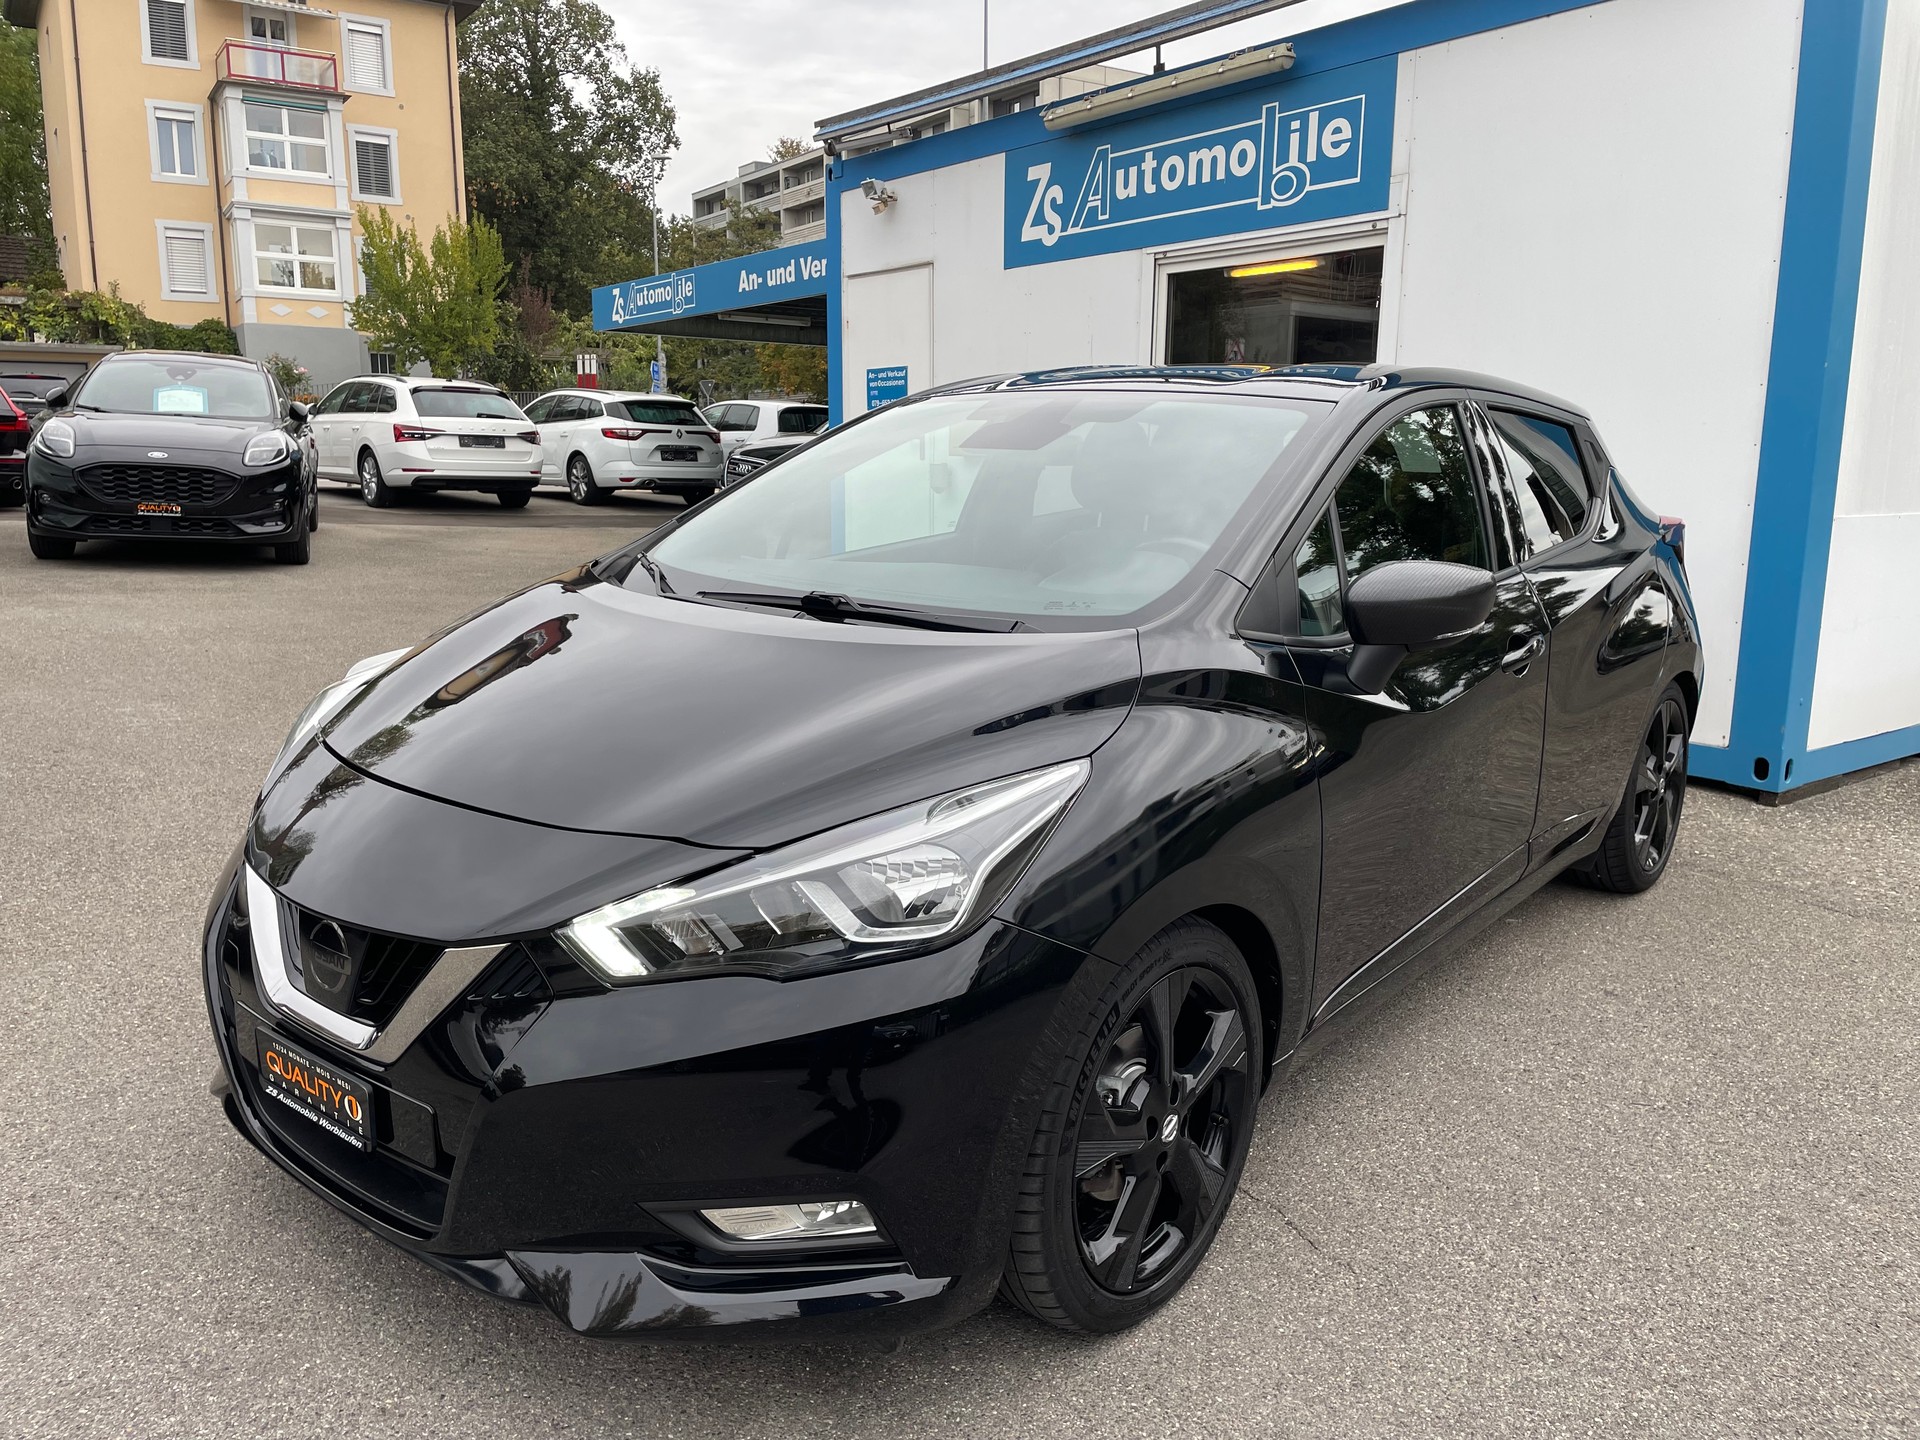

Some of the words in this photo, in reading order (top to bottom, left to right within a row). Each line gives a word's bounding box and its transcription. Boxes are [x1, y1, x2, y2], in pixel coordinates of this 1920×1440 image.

[1021, 162, 1064, 247] Zs
[1067, 102, 1352, 232] Automobile
[612, 287, 624, 324] Zs
[625, 273, 693, 318] Automobile
[738, 270, 763, 293] An-
[767, 259, 795, 287] und
[799, 256, 827, 281] Ver
[878, 379, 905, 387] Occasionen
[266, 1050, 342, 1109] QUALITY
[288, 1051, 310, 1068] MONATE
[316, 1066, 331, 1079] MOIS
[337, 1078, 351, 1091] MESI
[1069, 1008, 1120, 1120] MICHELIN
[269, 1073, 363, 1135] GARANTIE
[277, 1093, 318, 1122] Automobile
[318, 1117, 363, 1149] Worblaufen
